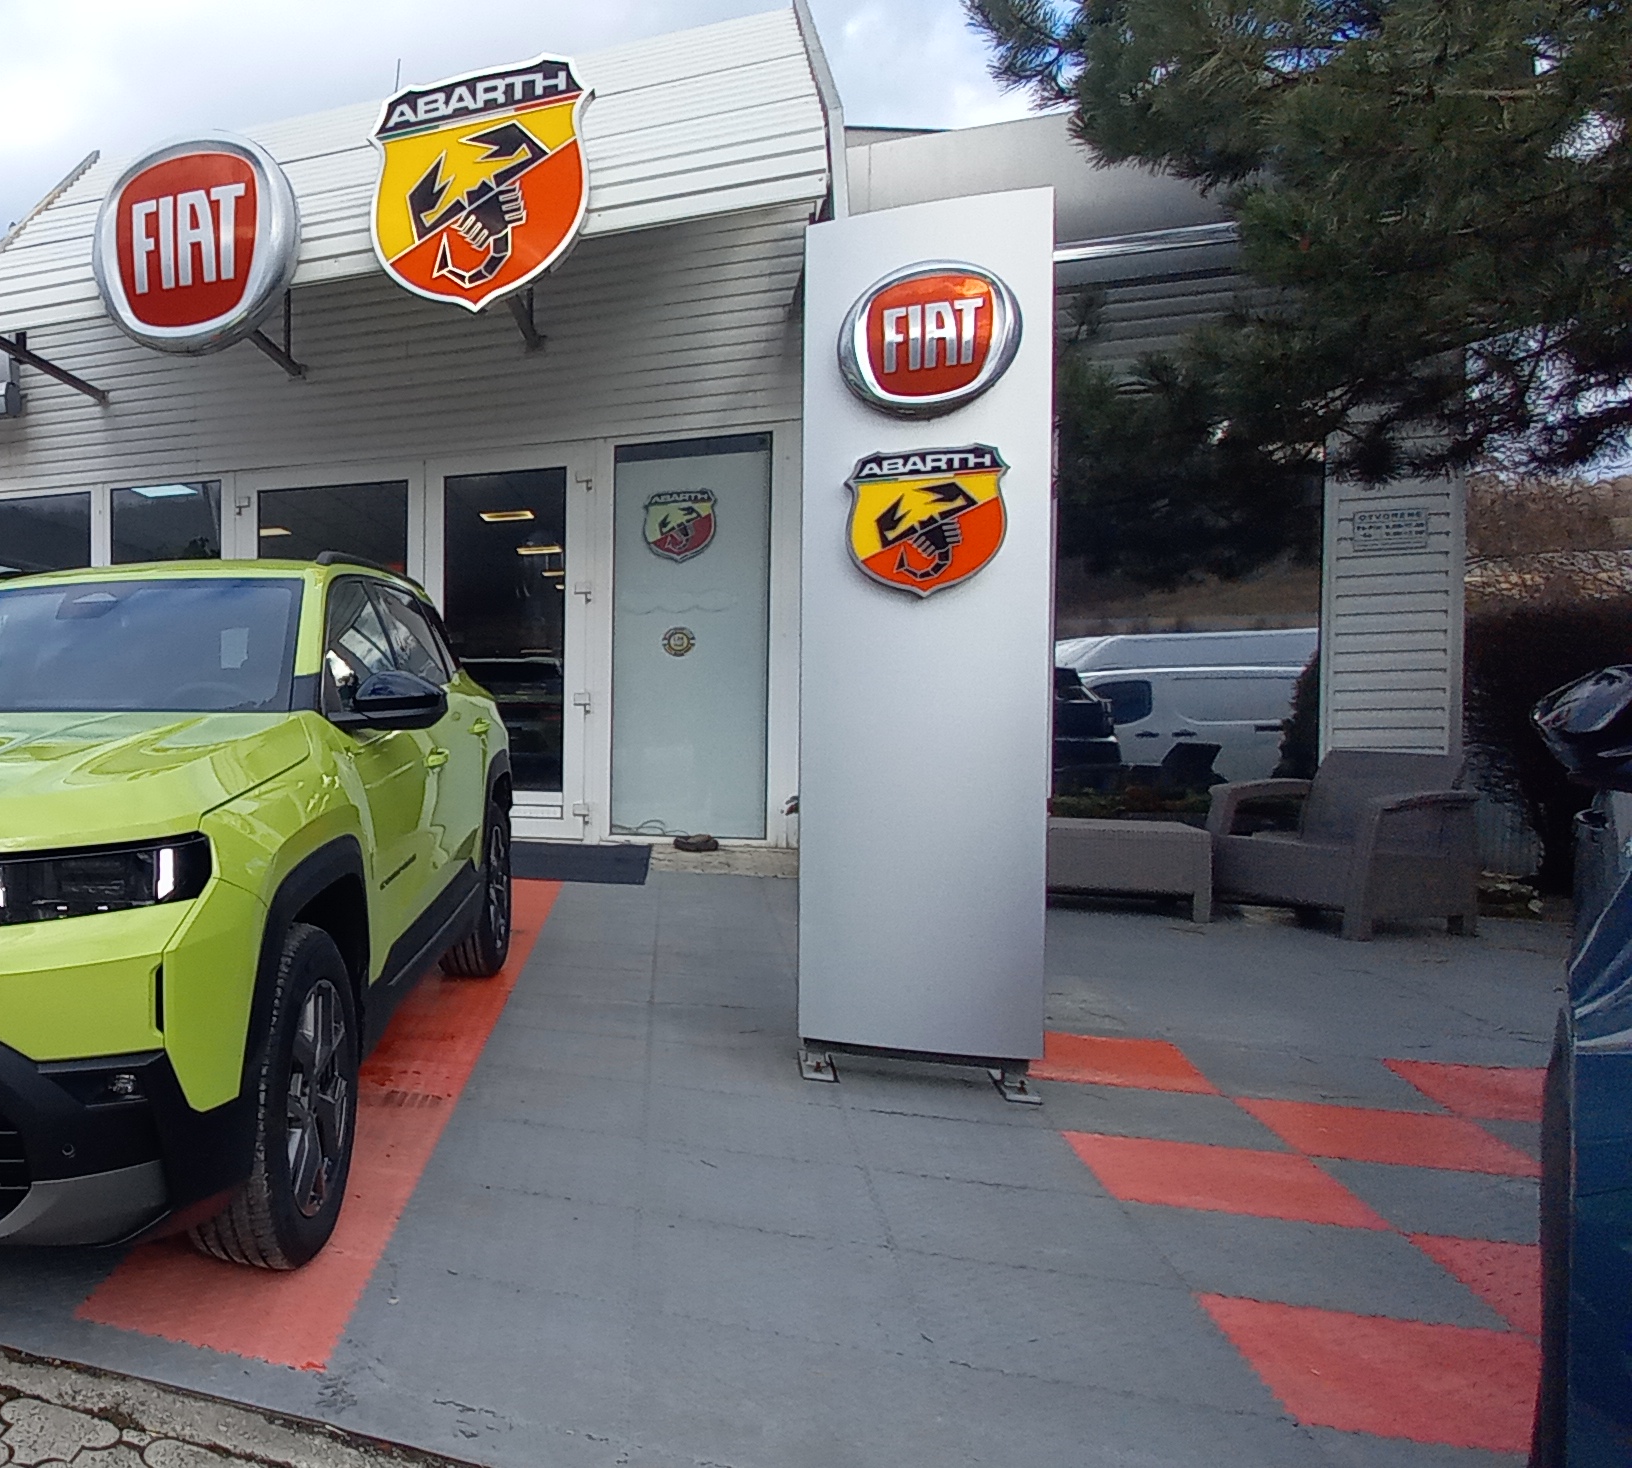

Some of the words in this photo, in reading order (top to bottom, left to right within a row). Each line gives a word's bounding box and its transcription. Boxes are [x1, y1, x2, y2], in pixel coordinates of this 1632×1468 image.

[386, 70, 567, 128] ABARTH
[131, 181, 247, 295] FIAT
[882, 297, 984, 374] FIAT
[860, 453, 991, 476] ABARTH
[651, 492, 708, 503] ABARTH
